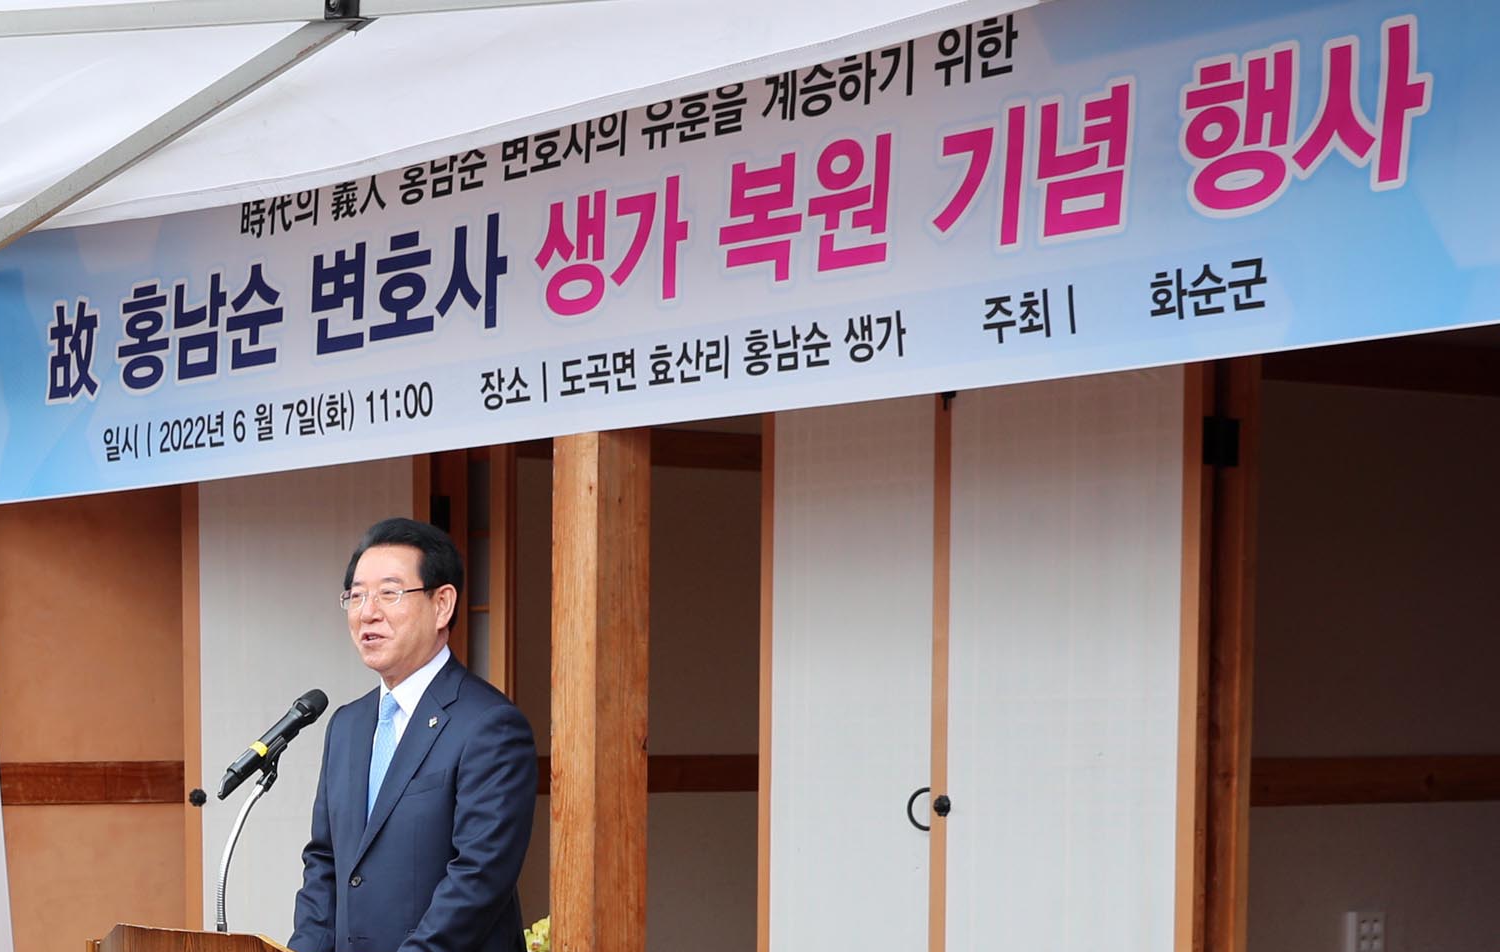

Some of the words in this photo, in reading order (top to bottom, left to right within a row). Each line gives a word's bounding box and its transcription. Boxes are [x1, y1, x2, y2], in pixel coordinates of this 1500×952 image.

[241, 188, 320, 238] 時代의
[332, 175, 386, 221] 義人
[399, 149, 487, 205] 홍남순
[501, 110, 628, 181] 변호사의
[641, 82, 747, 150] 유훈을
[762, 40, 915, 121] 계승하기
[935, 14, 1018, 86] 위한
[48, 301, 98, 400] 故
[118, 262, 284, 390] 홍남순
[310, 213, 507, 355] 변호사
[536, 175, 688, 317] 생가
[718, 131, 892, 282] 복원
[932, 83, 1131, 245] 기념
[1184, 22, 1427, 211] 행사
[983, 288, 1051, 344] 주최
[1150, 257, 1267, 320] 화순군
[480, 366, 531, 410] 장소
[560, 347, 637, 397] 도곡면
[648, 335, 730, 386] 효산리
[743, 321, 831, 377] 홍남순
[843, 309, 906, 363] 생가
[103, 423, 139, 462] 일시
[159, 410, 225, 452] 2022년
[282, 389, 355, 435] 7일(화)
[365, 381, 434, 424] 11:00
